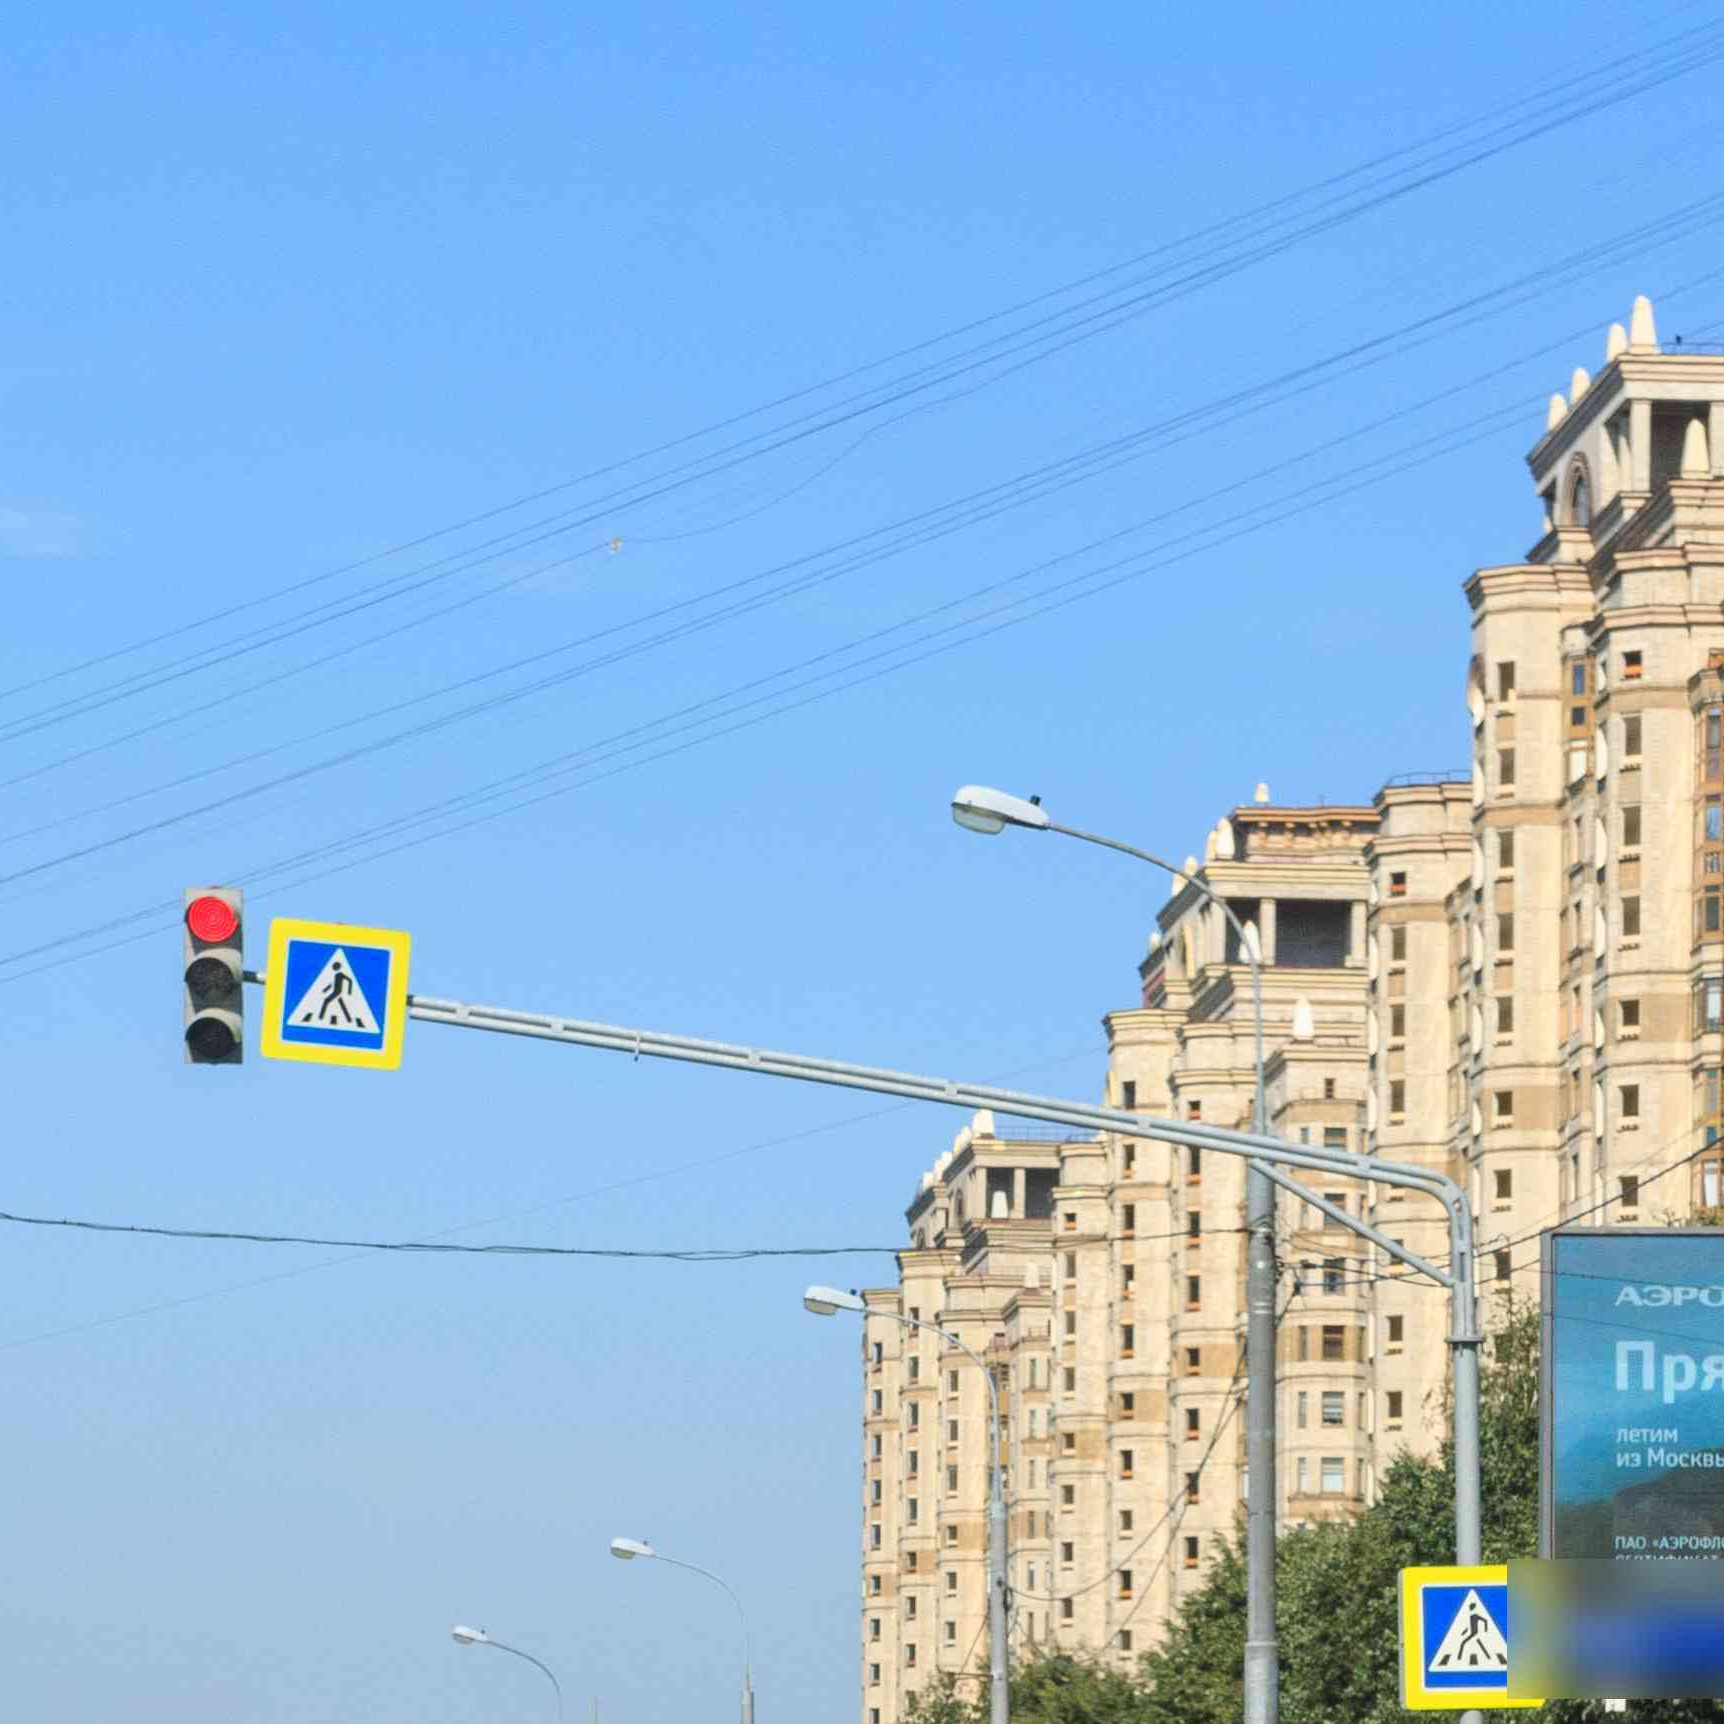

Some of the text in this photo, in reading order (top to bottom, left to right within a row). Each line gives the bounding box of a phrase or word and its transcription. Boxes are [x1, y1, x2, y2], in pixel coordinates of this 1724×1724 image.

[1616, 1427, 1678, 1444] летим
[1616, 1453, 1640, 1469] из
[1614, 1536, 1647, 1550] ПАО
